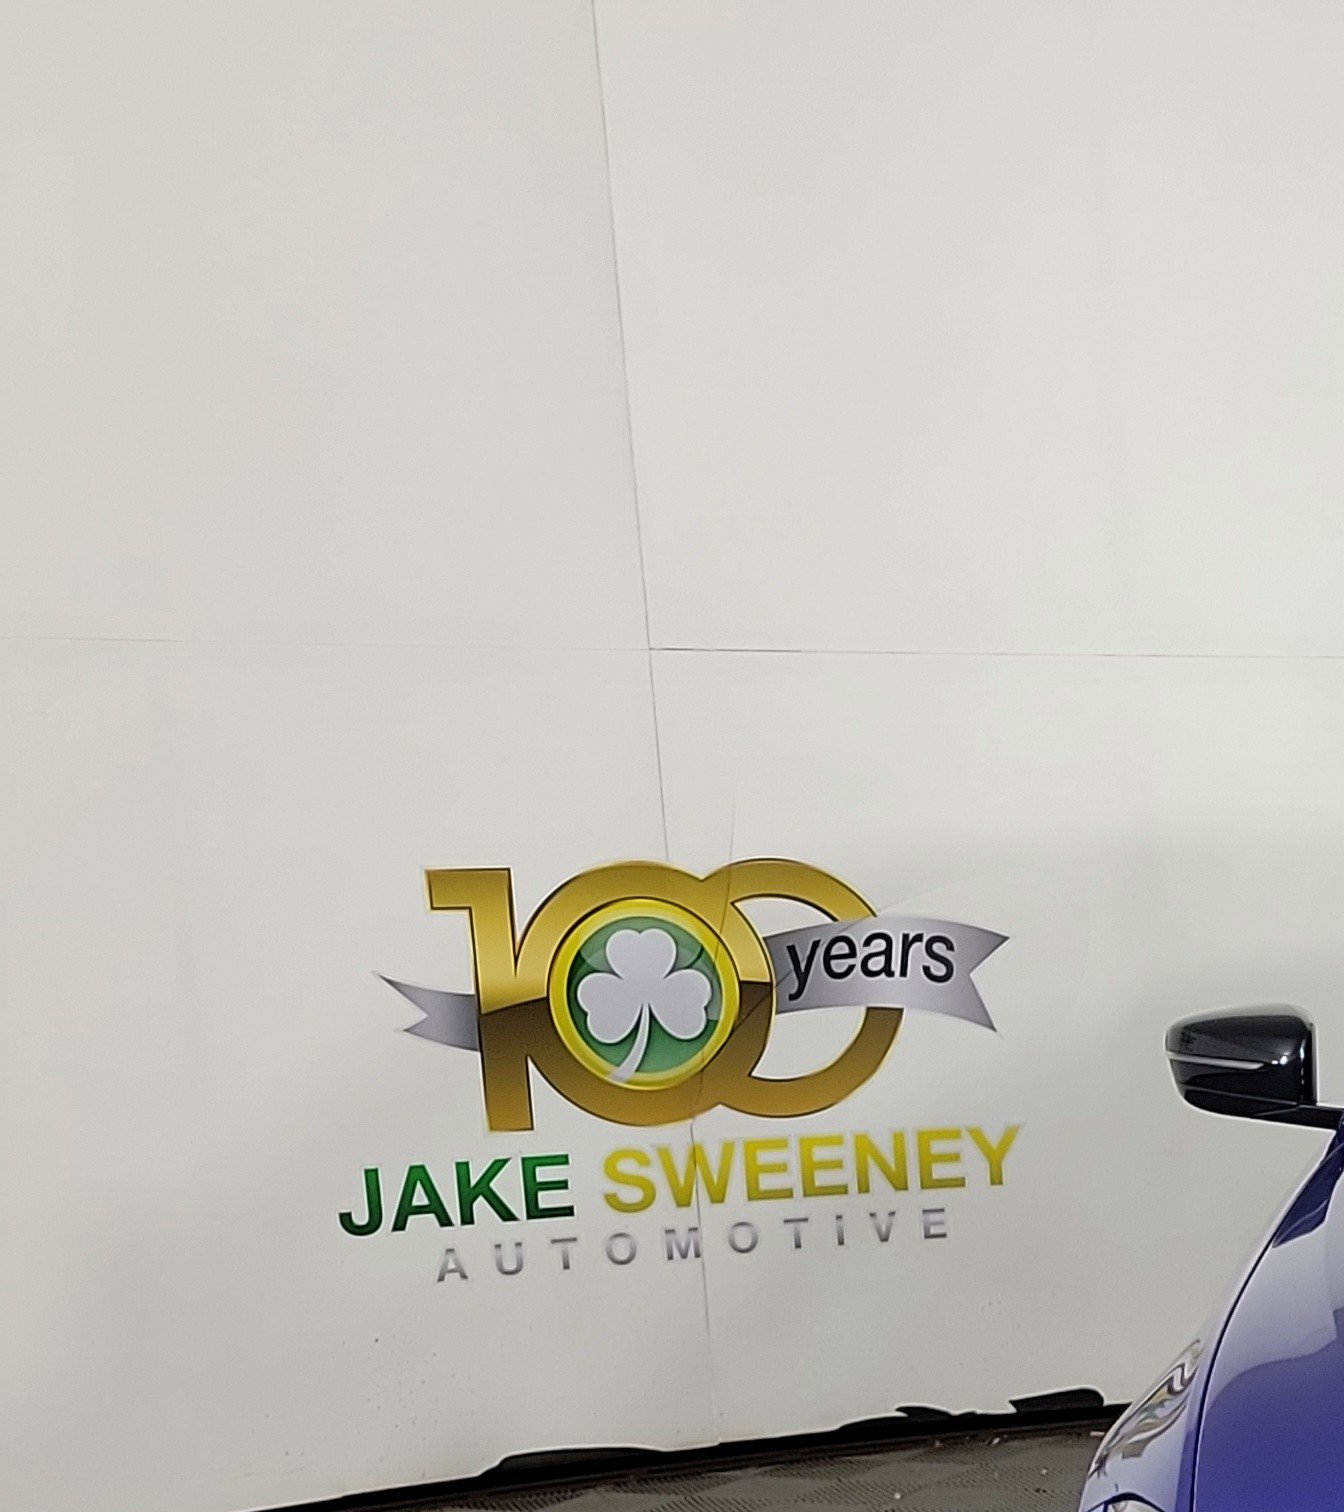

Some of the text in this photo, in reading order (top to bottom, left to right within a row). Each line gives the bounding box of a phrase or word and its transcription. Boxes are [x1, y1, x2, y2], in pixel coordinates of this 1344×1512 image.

[424, 858, 957, 1133] 100 years
[338, 1125, 1022, 1239] JAKE SWEENEY
[436, 1208, 948, 1284] AUTOMOTIVE
